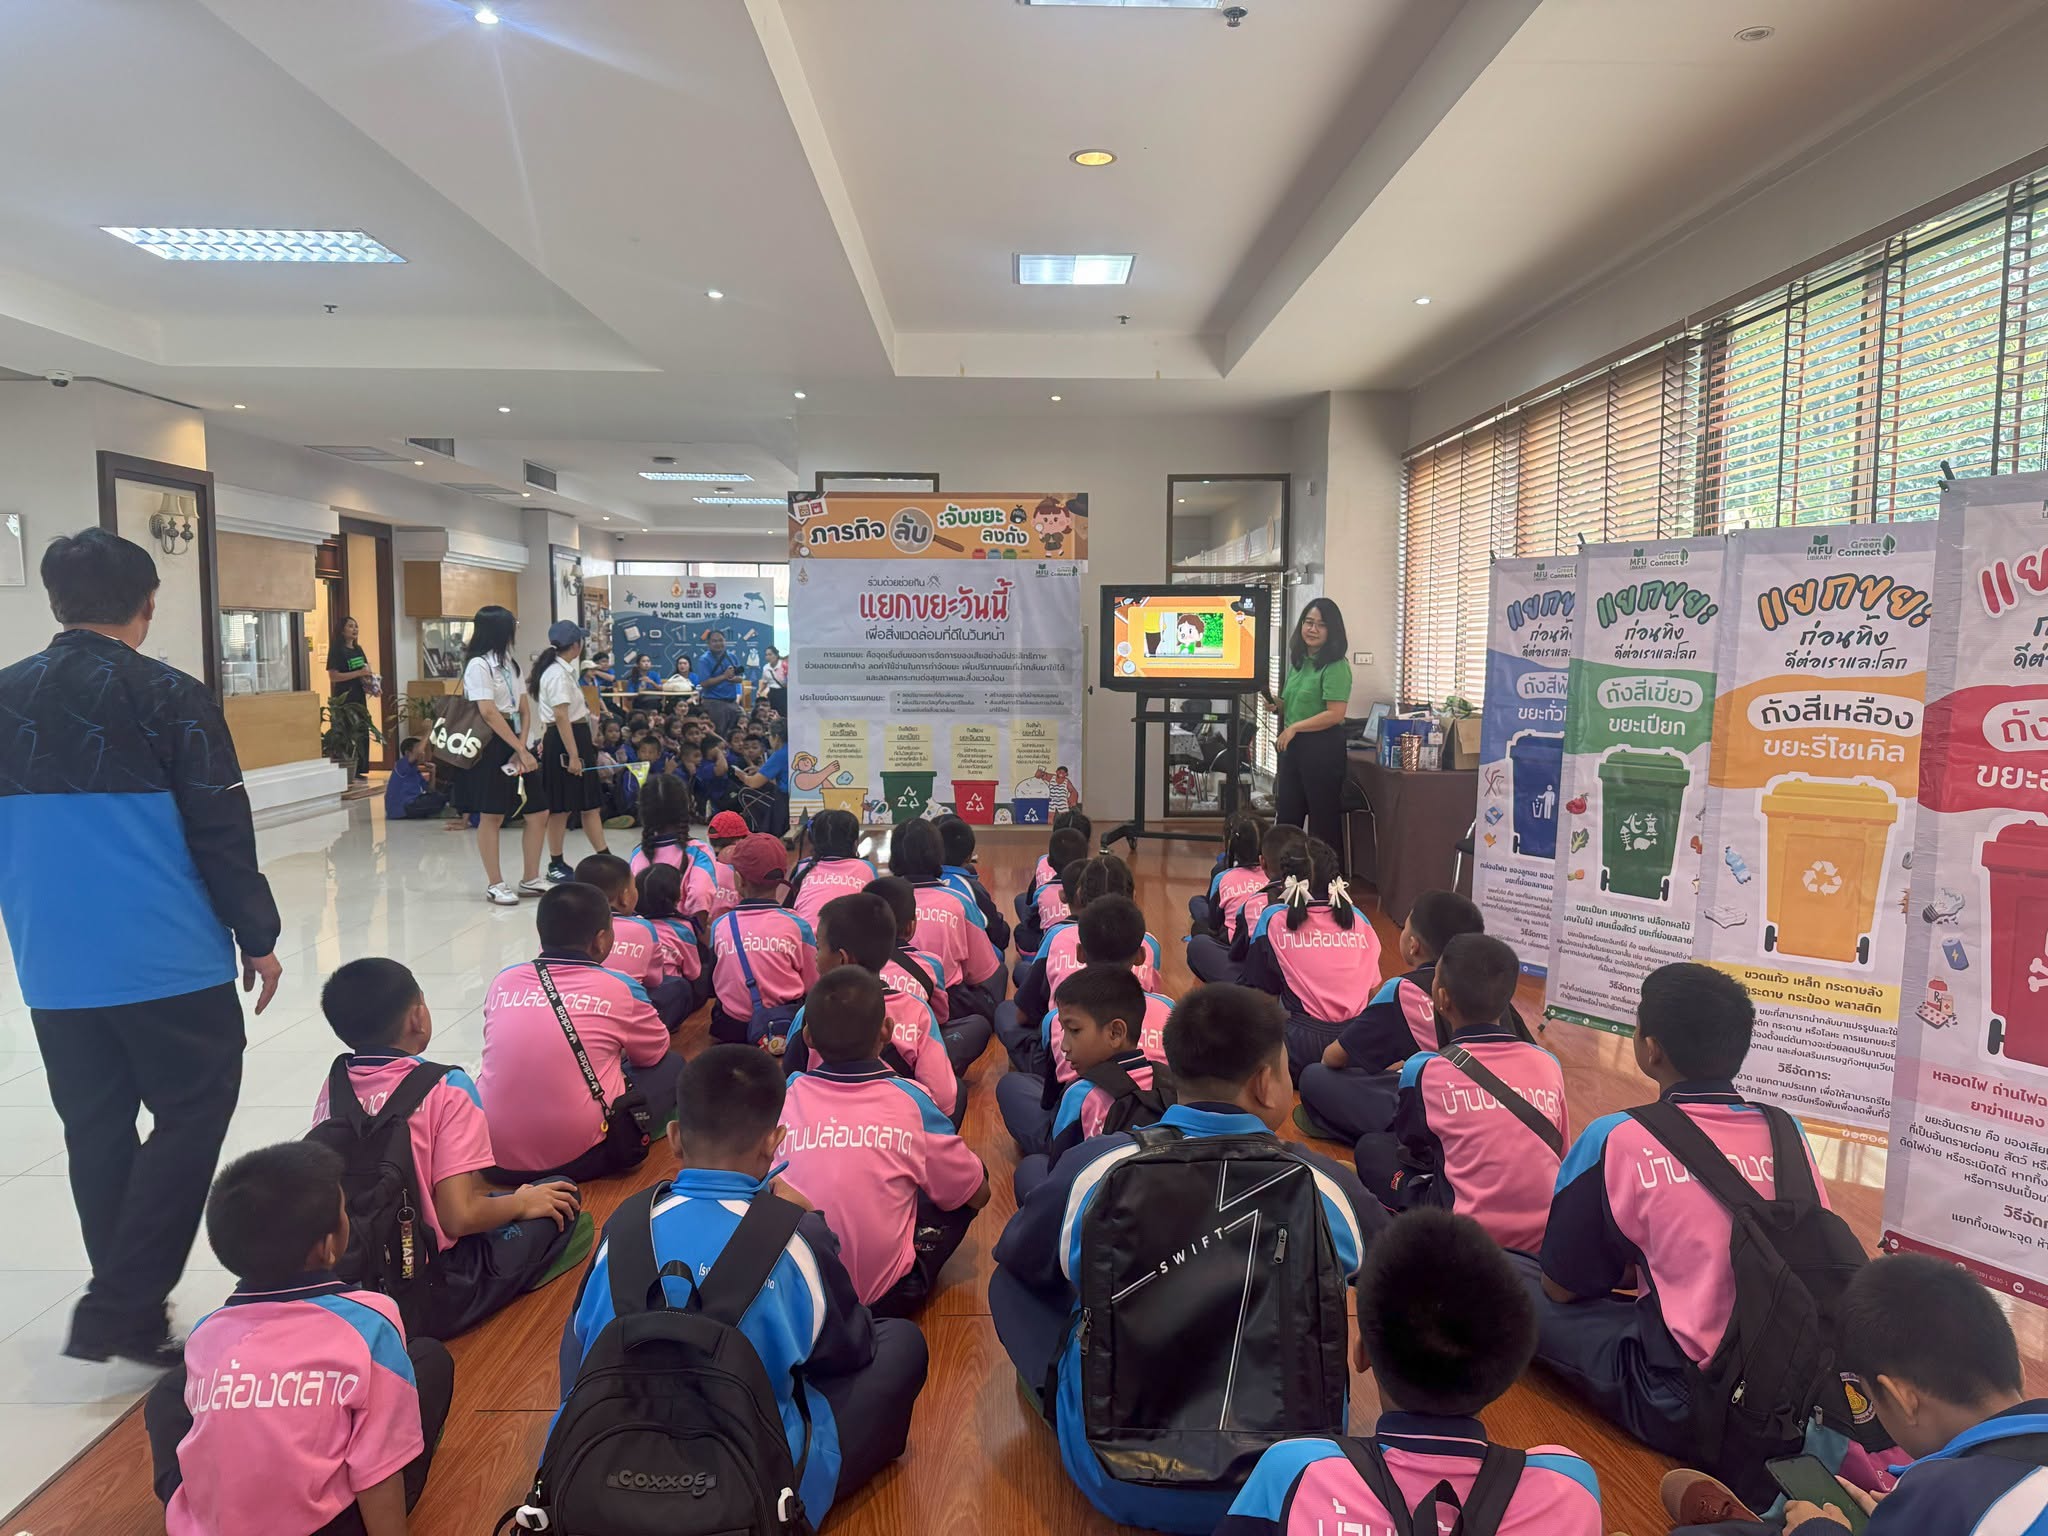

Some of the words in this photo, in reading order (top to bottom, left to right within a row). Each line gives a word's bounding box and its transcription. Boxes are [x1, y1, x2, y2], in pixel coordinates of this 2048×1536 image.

[810, 519, 885, 544] ภารกิจ
[893, 516, 928, 544] ลับ
[982, 527, 1028, 545] ลงถัง
[1808, 546, 1832, 555] MFU
[1851, 541, 1880, 549] Green
[1838, 548, 1880, 556] Connect
[1630, 558, 1647, 566] MFU
[868, 576, 925, 588] ร่วมด้วยช่วยกัน
[638, 601, 658, 609] How
[660, 601, 680, 611] long
[682, 600, 702, 608] until
[704, 600, 717, 608] it's
[860, 578, 1013, 620] แยกขยะวันนี้
[1597, 580, 1718, 628] แยกขยะ
[1758, 572, 1932, 631] แยกขยะ
[866, 625, 1005, 641] เพื่อสิ่งแวดล้อมที่ดีในวันหน้า
[1624, 614, 1684, 642] ก่อนทิ้ง
[1800, 614, 1888, 648] ก่อนทิ้ง
[1522, 644, 1571, 658] ดีต่อเราและ
[1614, 641, 1696, 660] ดีต่อเราและโลก
[1785, 647, 1908, 670] ดีต่อเราและโลก
[1606, 680, 1692, 706] ถังสีเขียว
[1518, 700, 1566, 721] ขยะทั่วไ
[1761, 694, 1914, 730] ถังสีเหลือง
[1608, 716, 1686, 736] ขยะเปียก
[1764, 734, 1904, 762] ขยะรีไซเคิล
[540, 969, 554, 992] adidas
[1608, 980, 1640, 995] วิธีจัดการ
[1744, 970, 1788, 984] ขวดแก้ว
[1794, 976, 1820, 988] เหล็ก
[1826, 982, 1884, 998] กระดาษลัง
[1788, 992, 1830, 1006] กระป๋อง
[1834, 1000, 1882, 1014] พลาสติก
[556, 1006, 573, 1032] adidas
[1772, 1022, 1802, 1033] กระดาษ
[1843, 1033, 1896, 1048] การแยกขยะรี
[578, 1050, 595, 1080] adidas
[1778, 1063, 1832, 1080] วิธีจัดการ:
[1820, 1086, 1890, 1106] เพื่อให้สามารถรีไซ
[1932, 1070, 1988, 1092] หลอดไฟ
[1993, 1083, 2048, 1107] ถ่านไฟฉ
[1782, 1093, 1891, 1119] ควรบีบหรือพับเพื่อลดพื้นที่จั
[1971, 1101, 2045, 1128] ยาฆ่าแมลง
[1925, 1115, 1982, 1136] ขยะอันตราย
[1986, 1130, 2000, 1142] คือ
[1900, 1137, 1942, 1157] ติดไฟง่าย
[1946, 1152, 2007, 1176] หรือระเบิดได้
[1909, 1122, 2000, 1158] ที่เป็นอันตรายต่อคน
[2004, 1151, 2028, 1165] สัตว์
[1964, 1173, 2048, 1203] หรือการปนเปื้อน
[1952, 1213, 2032, 1245] แยกทิ้งเฉพาะจุด
[1160, 1228, 1224, 1274] SWIFT
